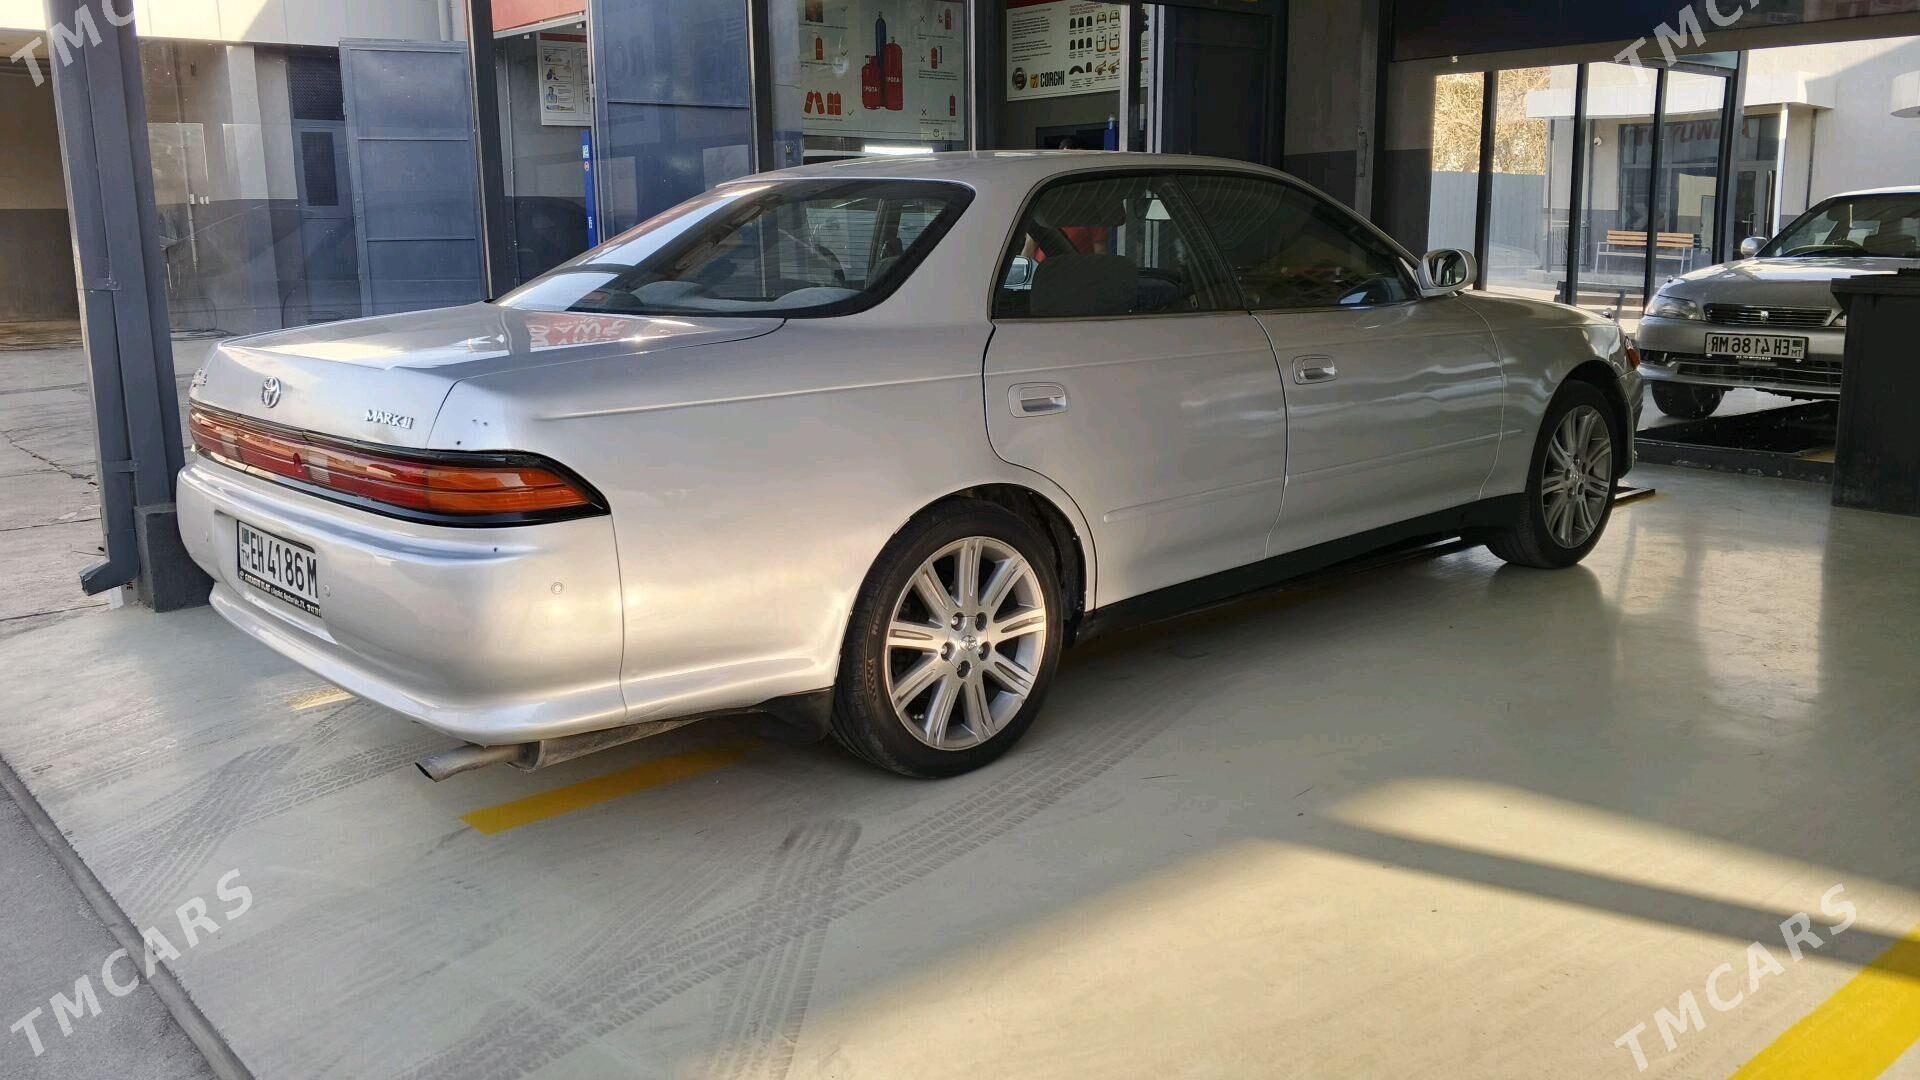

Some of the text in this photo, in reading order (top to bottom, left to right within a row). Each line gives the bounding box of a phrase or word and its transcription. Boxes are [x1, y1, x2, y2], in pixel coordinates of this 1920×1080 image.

[1040, 70, 1065, 88] CORGHI
[250, 531, 265, 573] EH
[267, 540, 304, 591] 4186
